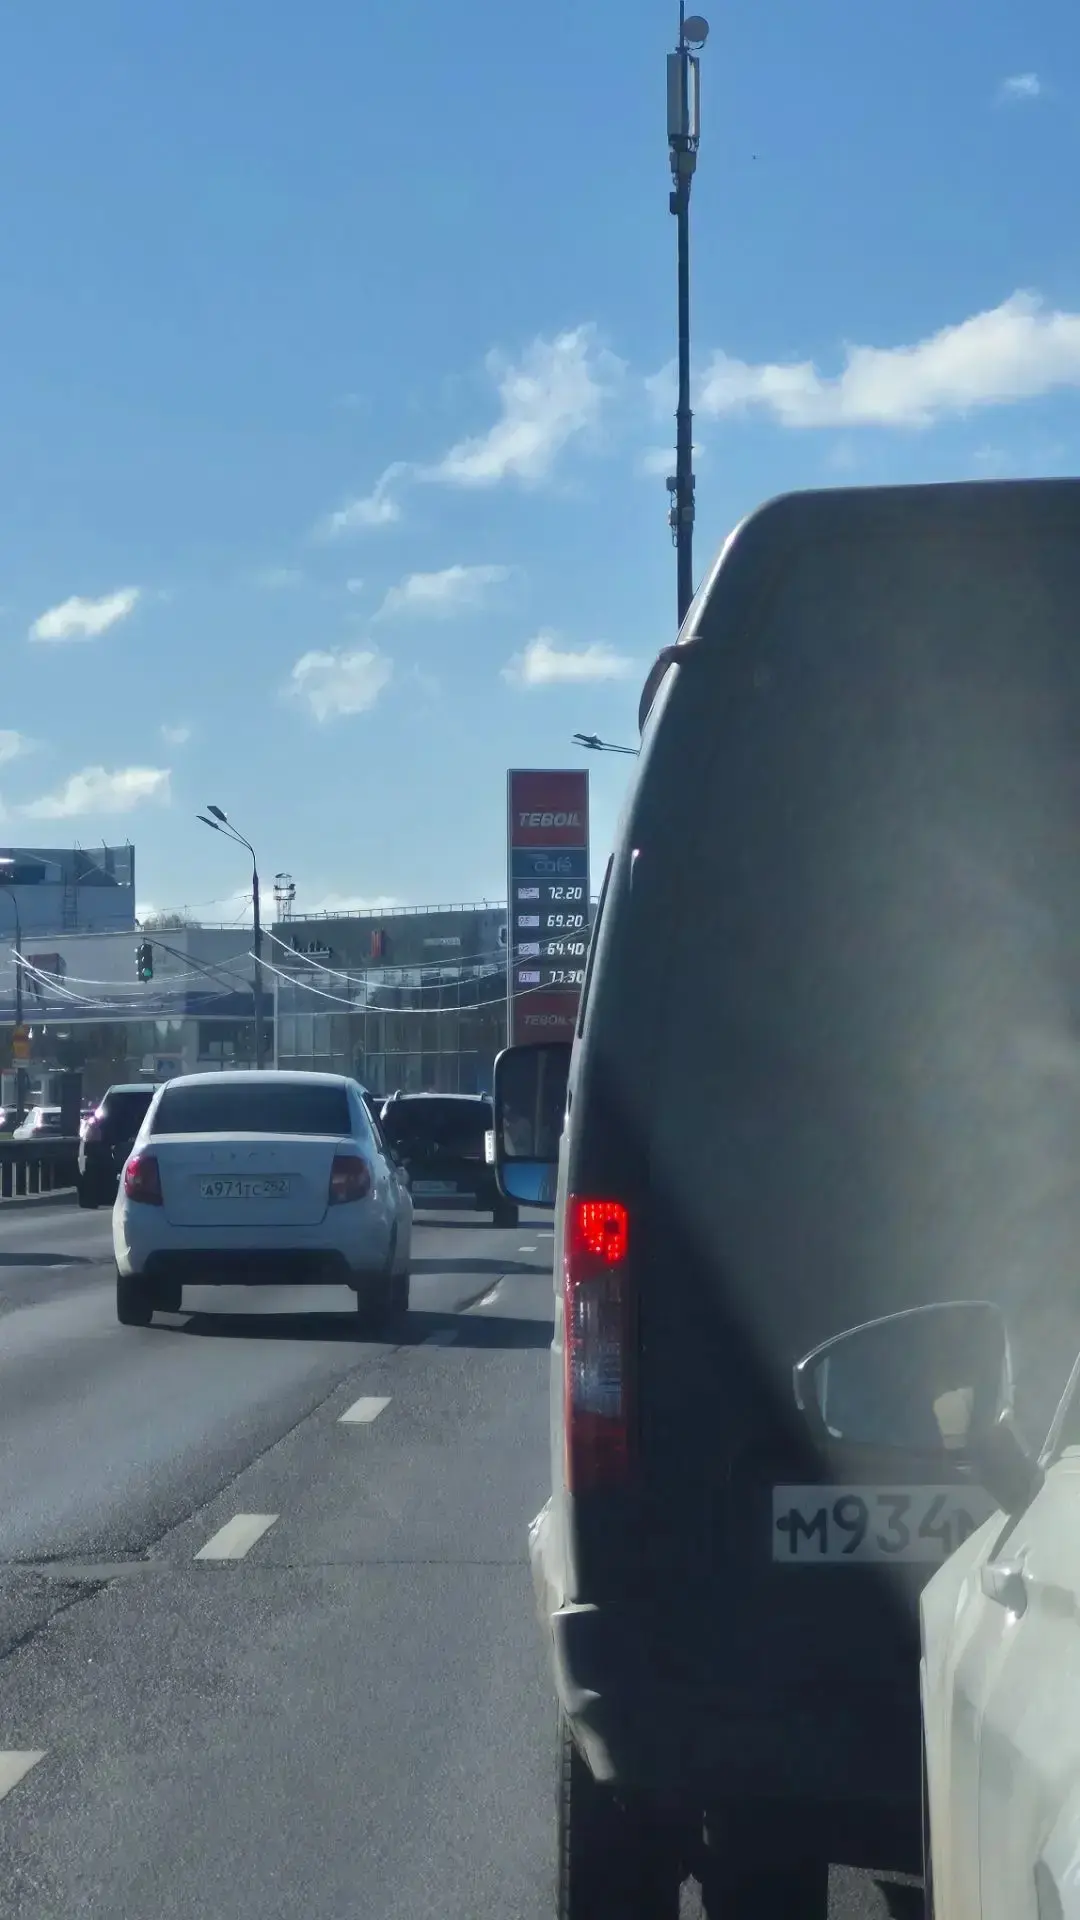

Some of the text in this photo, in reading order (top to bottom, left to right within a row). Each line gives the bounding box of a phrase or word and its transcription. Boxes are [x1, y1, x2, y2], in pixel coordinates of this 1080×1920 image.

[519, 812, 581, 827] TEBOIL
[548, 886, 583, 900] 72.20
[547, 914, 583, 927] 69.20
[547, 942, 585, 956] 64.40
[549, 970, 586, 984] 77.30
